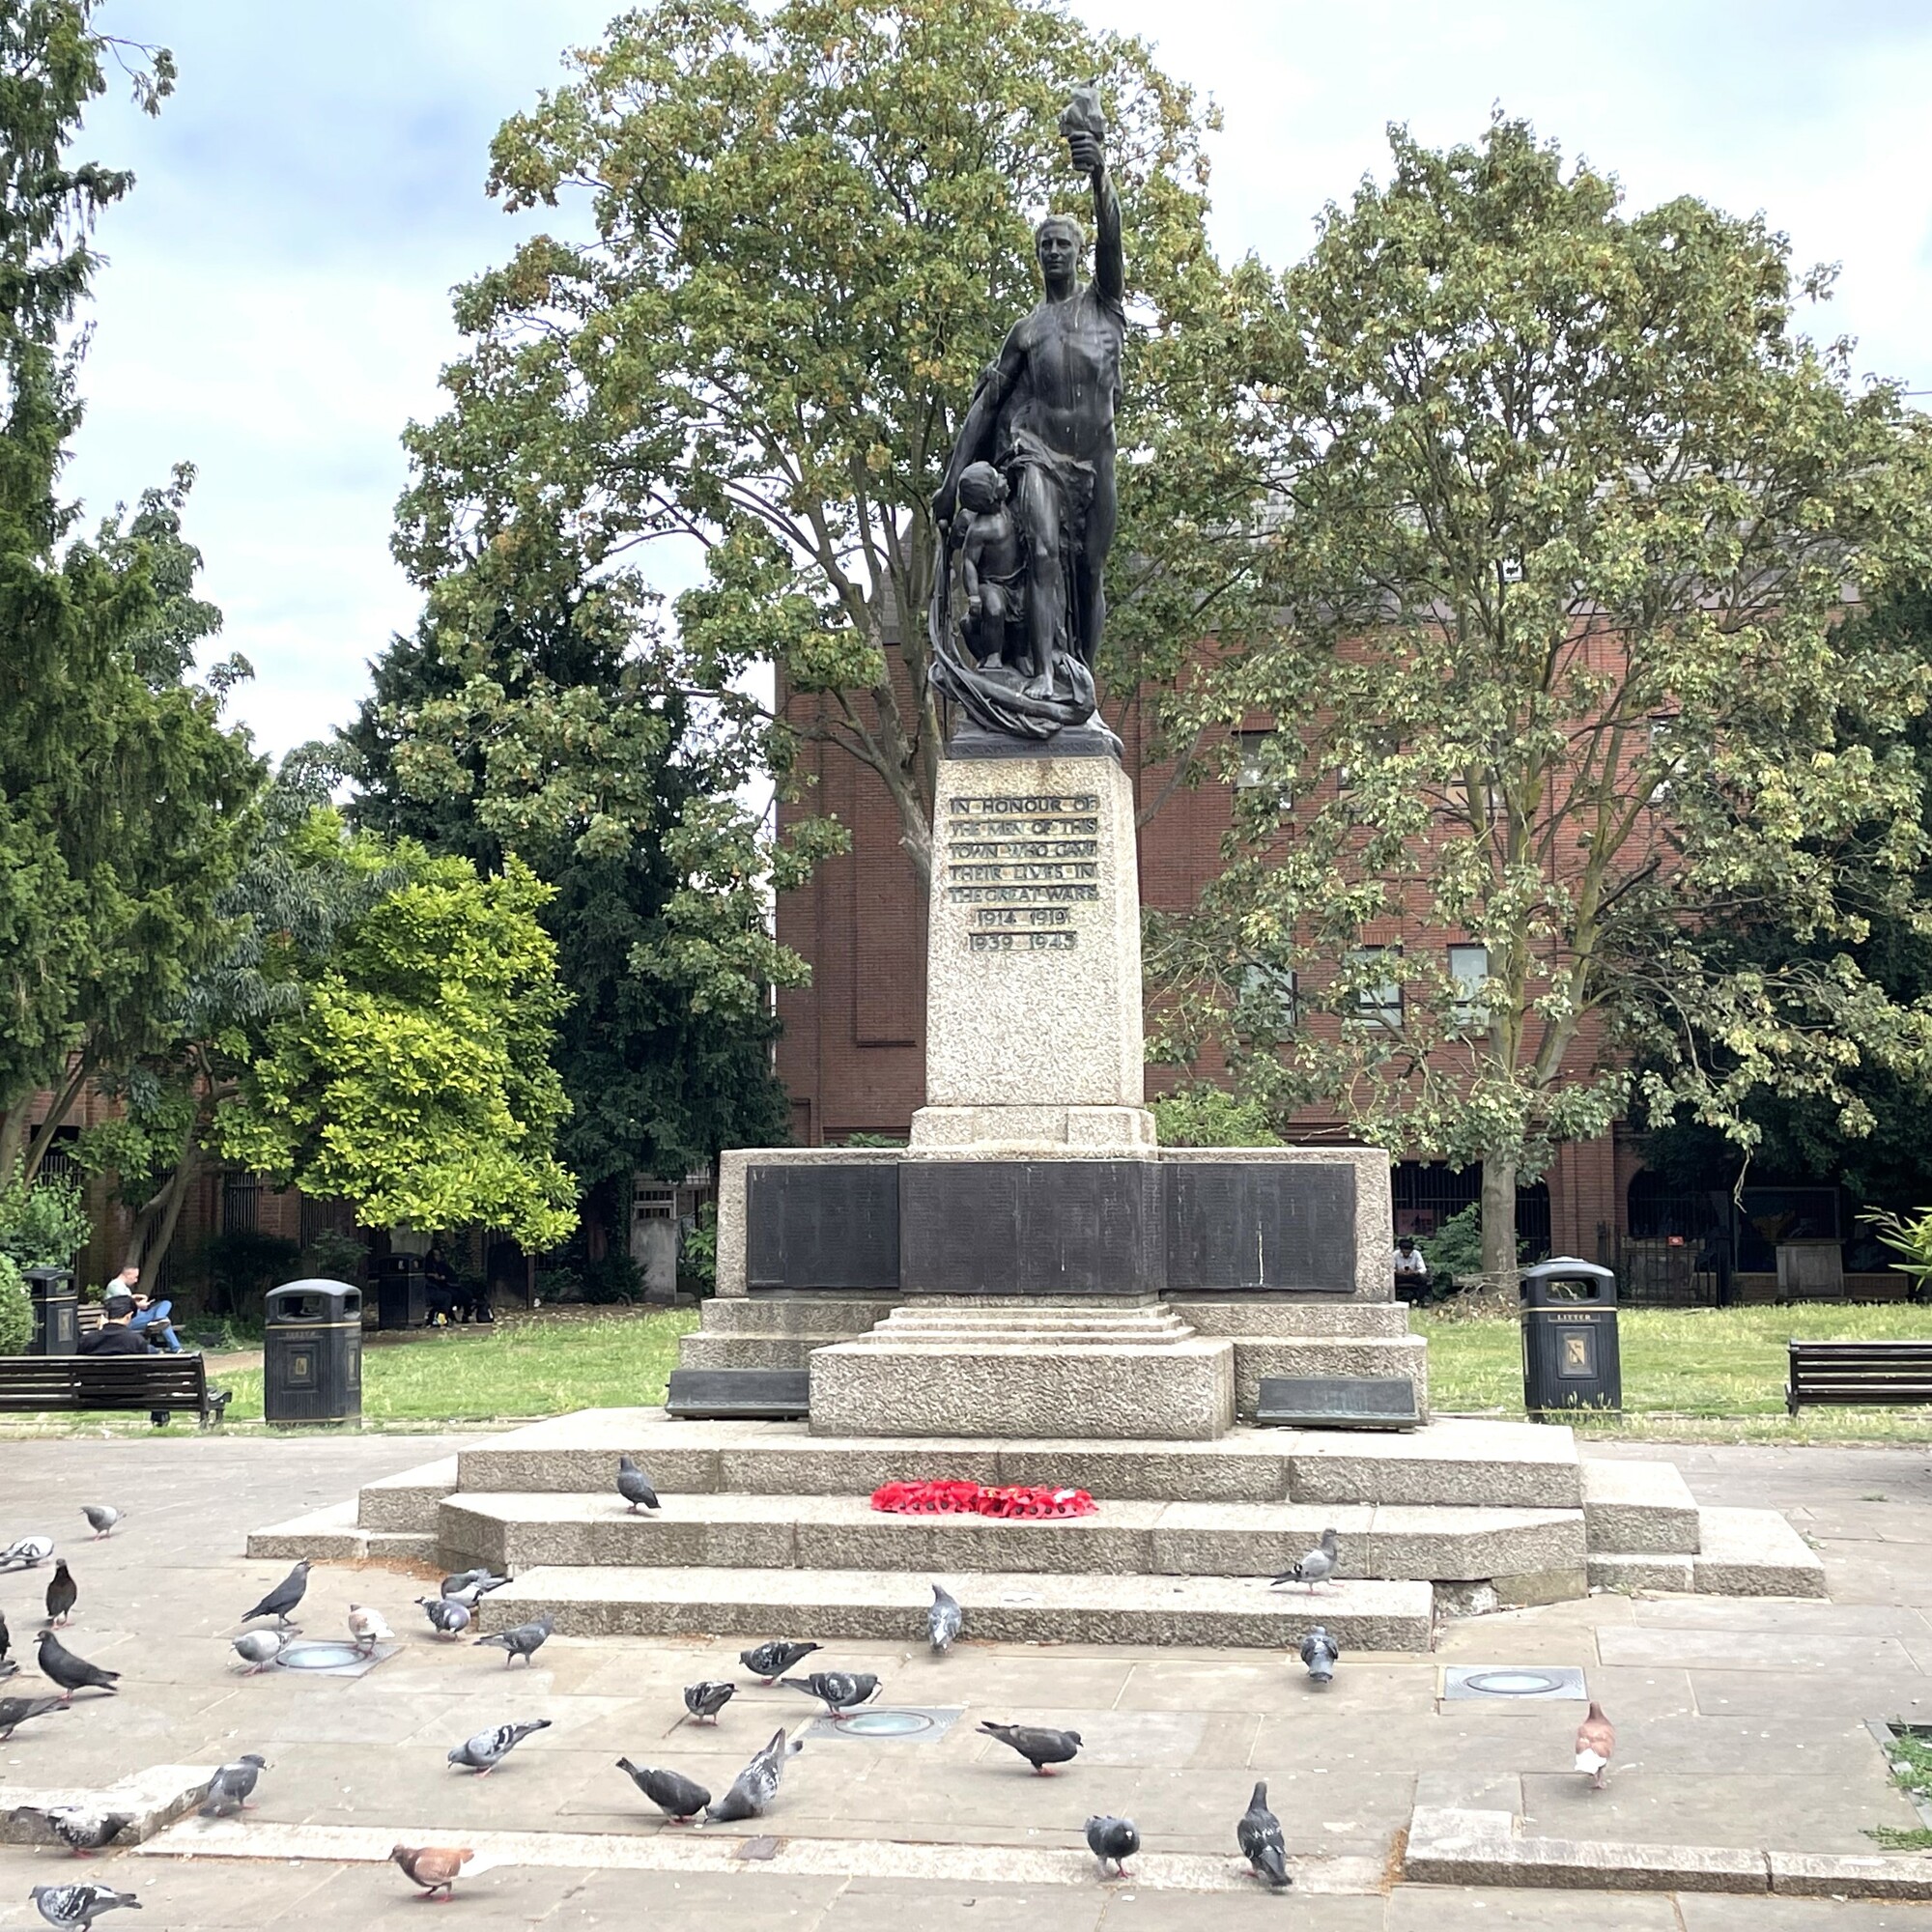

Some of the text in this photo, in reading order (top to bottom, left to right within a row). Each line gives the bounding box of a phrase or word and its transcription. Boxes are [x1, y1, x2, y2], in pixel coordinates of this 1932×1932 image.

[951, 797, 1099, 813] IN HONOUR OF
[950, 819, 1097, 836] THE MEN OF THIS
[950, 841, 1096, 859] TOWN WHO GAVE
[950, 864, 1094, 881] THEIR LIVES IN
[950, 886, 1098, 902] THE GREAT WARS
[978, 910, 1017, 925] 1914
[969, 933, 1075, 951] 1939 1945
